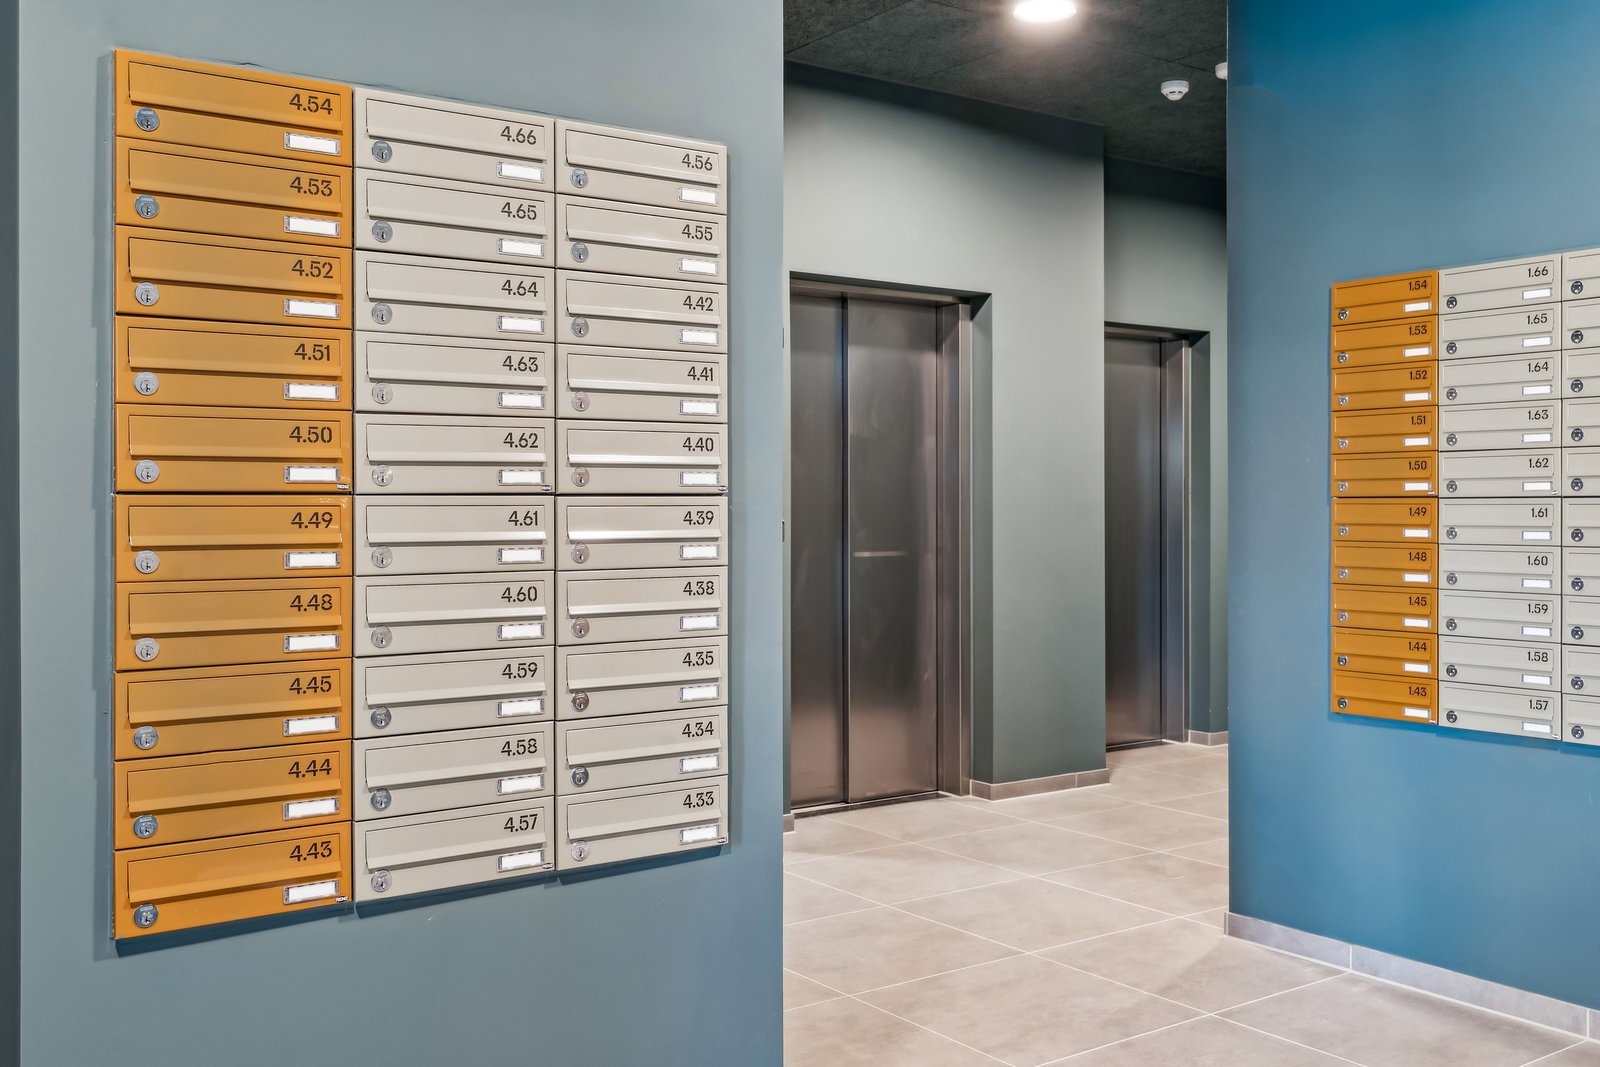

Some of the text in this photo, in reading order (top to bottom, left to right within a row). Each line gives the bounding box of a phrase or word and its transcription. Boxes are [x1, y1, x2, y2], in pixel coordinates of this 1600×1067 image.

[289, 93, 334, 115] 4.54
[501, 126, 538, 146] 4.66
[682, 154, 713, 172] 4.56
[290, 176, 334, 197] 4.53
[501, 202, 538, 221] 4.65
[682, 225, 713, 242] 4.55
[292, 259, 334, 279] 4.52
[1528, 266, 1549, 278] 1.66
[502, 280, 538, 298] 4.64
[1409, 280, 1427, 291] 1.54
[683, 296, 714, 312] 4.42
[1528, 314, 1548, 325] 1.65
[1409, 325, 1427, 336] 1.53
[294, 344, 331, 362] 4.51
[503, 356, 539, 373] 4.63
[1528, 362, 1549, 373] 1.64
[688, 367, 714, 382] 4.41
[1410, 371, 1427, 380] 1.52
[1411, 416, 1426, 425] 1.51
[1528, 410, 1549, 420] 1.63
[289, 426, 333, 444] 4.50
[504, 433, 539, 449] 4.62
[683, 437, 714, 452] 4.40
[1409, 461, 1427, 470] 1.50
[1529, 458, 1549, 468] 1.62
[508, 511, 538, 526] 4.61
[683, 511, 714, 526] 4.39
[1410, 508, 1427, 517] 1.49
[1532, 508, 1548, 518] 1.61
[291, 512, 334, 529] 4.49
[1409, 552, 1427, 562] 1.48
[1528, 556, 1548, 566] 1.60
[501, 586, 538, 603] 4.60
[683, 581, 714, 596] 4.38
[290, 594, 333, 612] 4.48
[1409, 597, 1427, 606] 1.45
[1528, 604, 1548, 614] 1.59
[1409, 642, 1427, 652] 1.44
[683, 651, 714, 667] 4.35
[1528, 651, 1548, 662] 1.58
[502, 662, 538, 680] 4.59
[289, 676, 332, 695] 4.45
[1409, 686, 1427, 697] 1.43
[1530, 700, 1548, 711] 1.57
[682, 721, 714, 738] 4.34
[501, 738, 538, 756] 4.58
[288, 758, 332, 779] 4.44
[683, 791, 714, 808] 4.33
[504, 814, 538, 833] 4.57
[290, 840, 332, 862] 4.43
